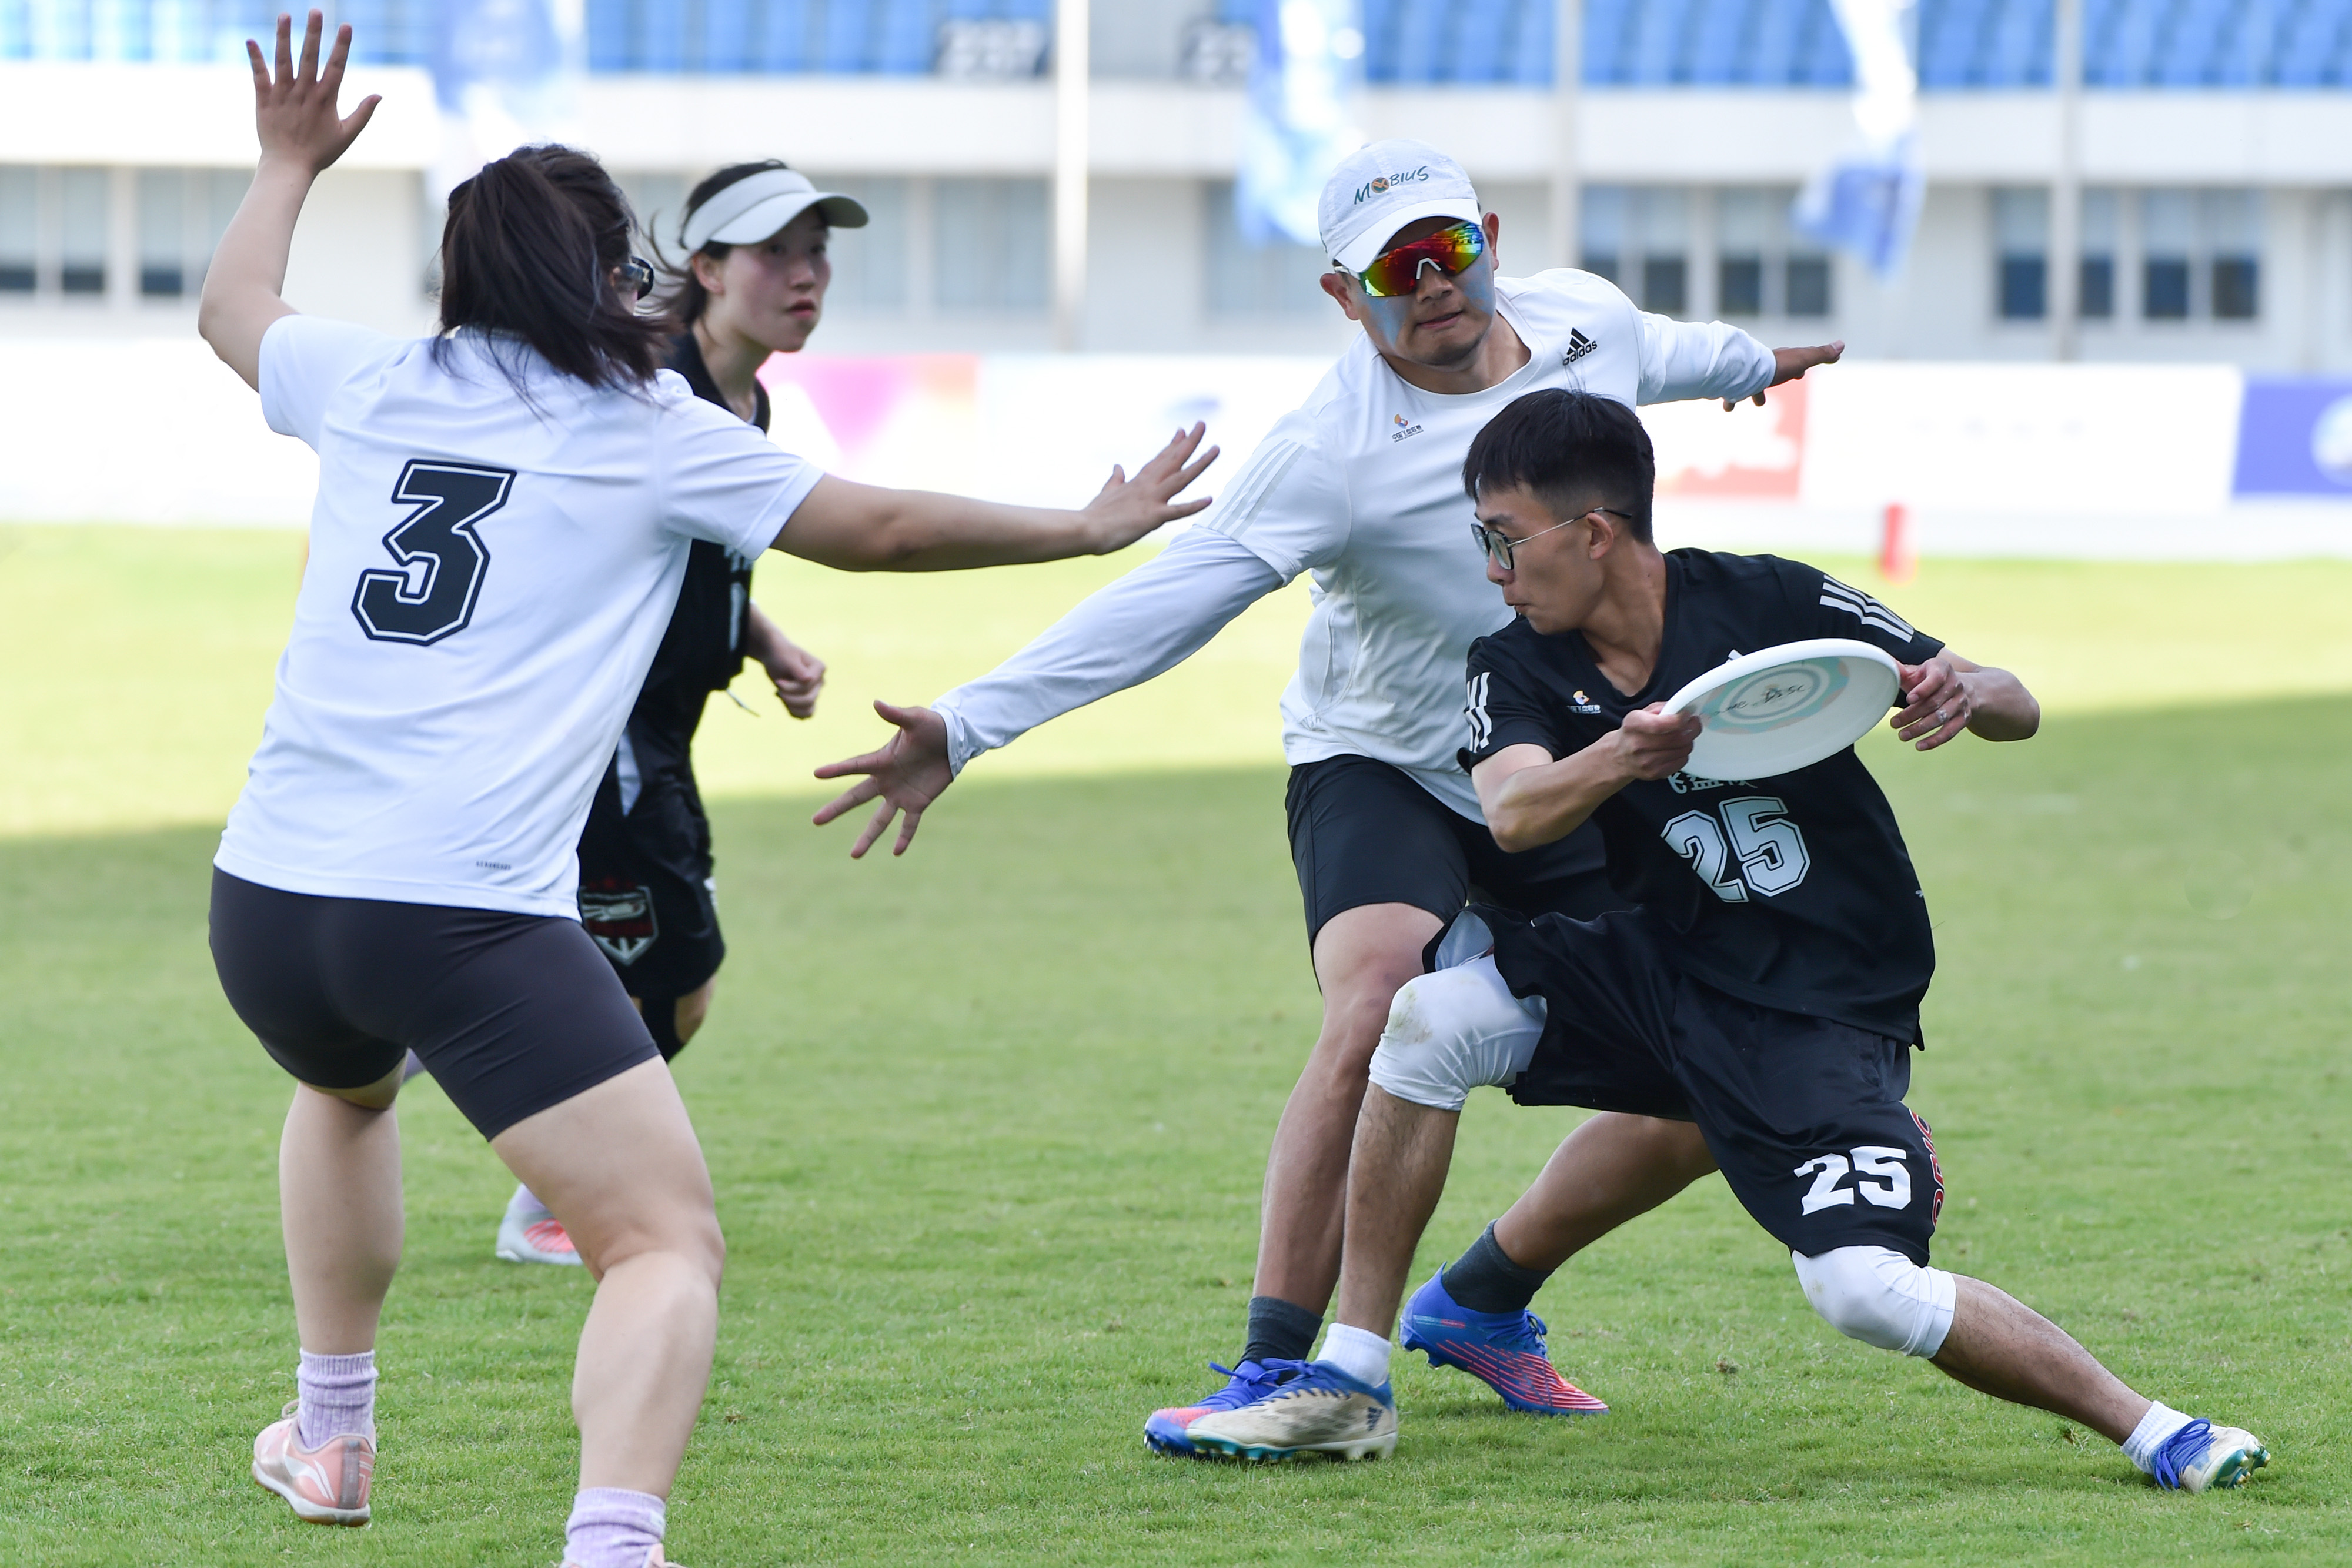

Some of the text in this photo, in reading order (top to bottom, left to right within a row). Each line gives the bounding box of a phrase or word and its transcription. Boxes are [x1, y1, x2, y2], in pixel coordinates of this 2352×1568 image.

[1562, 340, 1598, 366] adidas
[351, 459, 517, 647] 3
[1660, 795, 1810, 903] 25
[1793, 1146, 1911, 1216] 25
